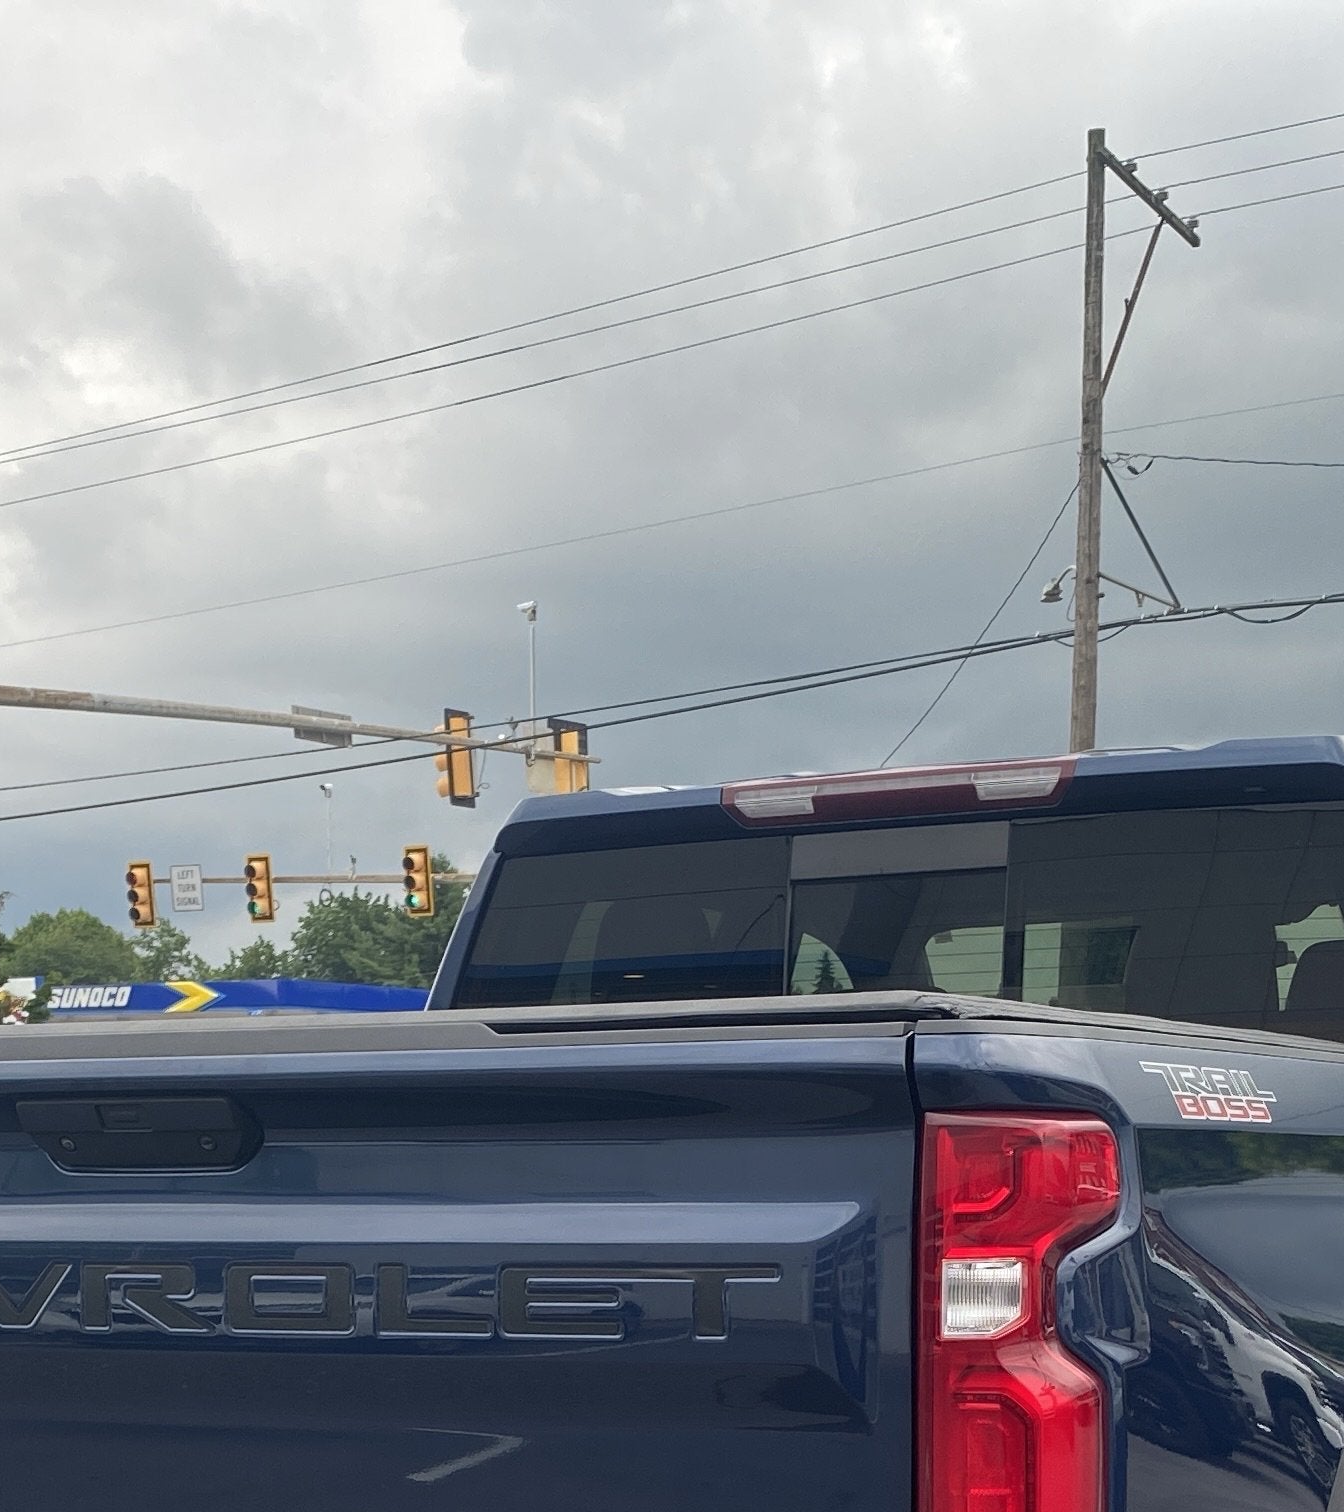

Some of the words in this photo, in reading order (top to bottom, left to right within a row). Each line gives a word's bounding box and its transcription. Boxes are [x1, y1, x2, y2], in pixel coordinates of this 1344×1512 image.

[47, 986, 132, 1009] SUNOCO
[1138, 1060, 1278, 1102] TRAIL
[1174, 1093, 1273, 1123] BOSS
